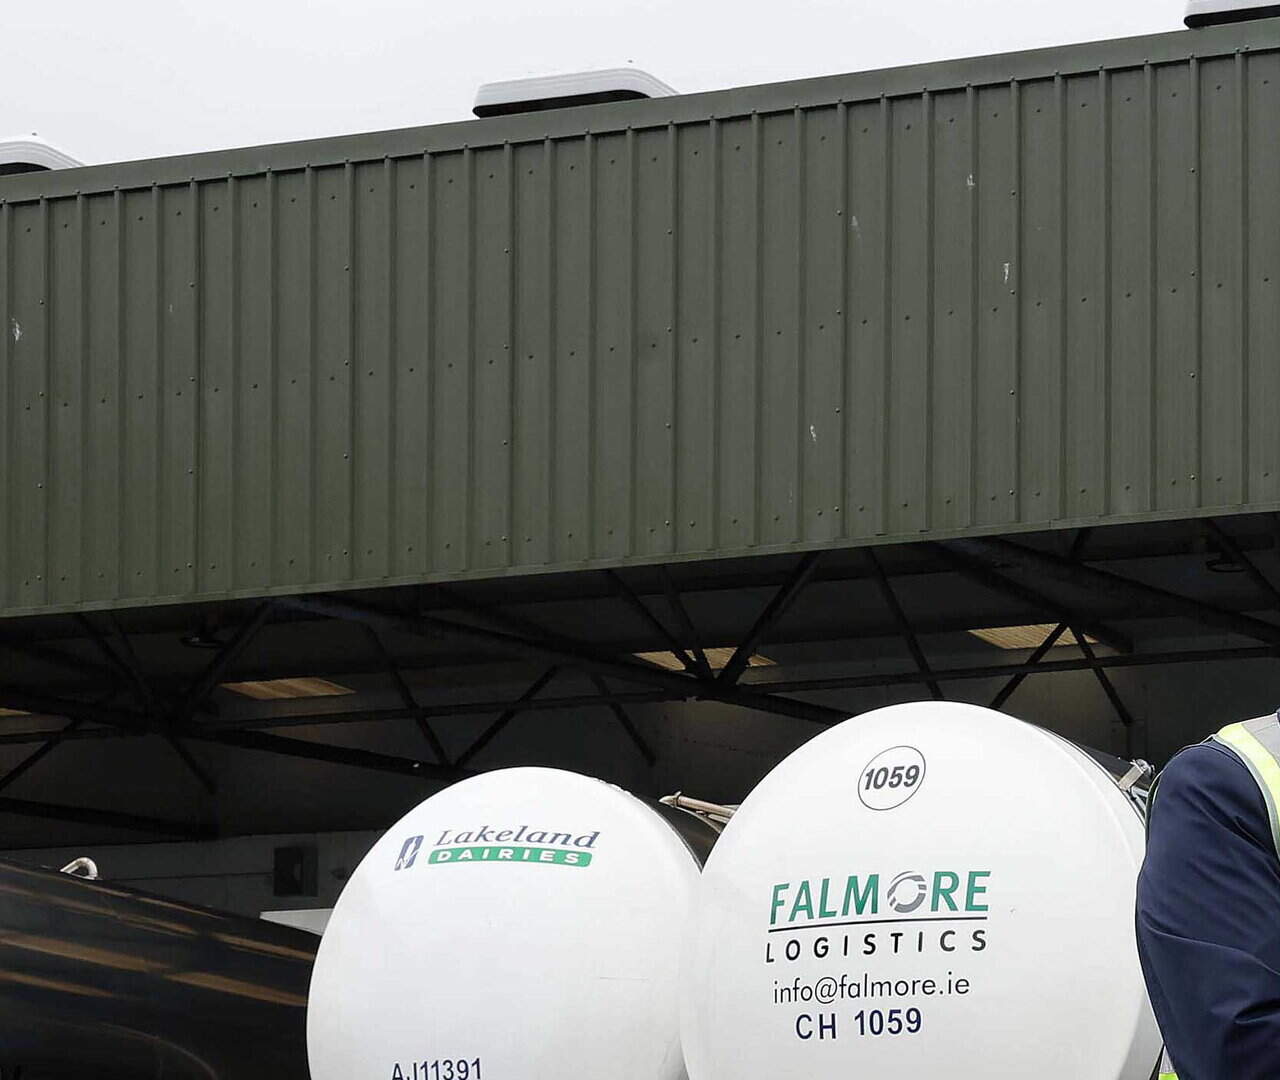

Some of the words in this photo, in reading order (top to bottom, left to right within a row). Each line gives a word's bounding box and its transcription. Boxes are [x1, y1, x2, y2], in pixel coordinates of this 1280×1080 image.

[864, 764, 921, 793] 1059
[433, 825, 600, 848] Lakeland
[437, 848, 580, 864] DAIRIES
[769, 870, 991, 925] FALMORE
[766, 930, 987, 963] LOGISTICS
[774, 971, 970, 1005] info@falmore.ie
[795, 1013, 837, 1040] CH
[854, 1007, 922, 1036] 1059
